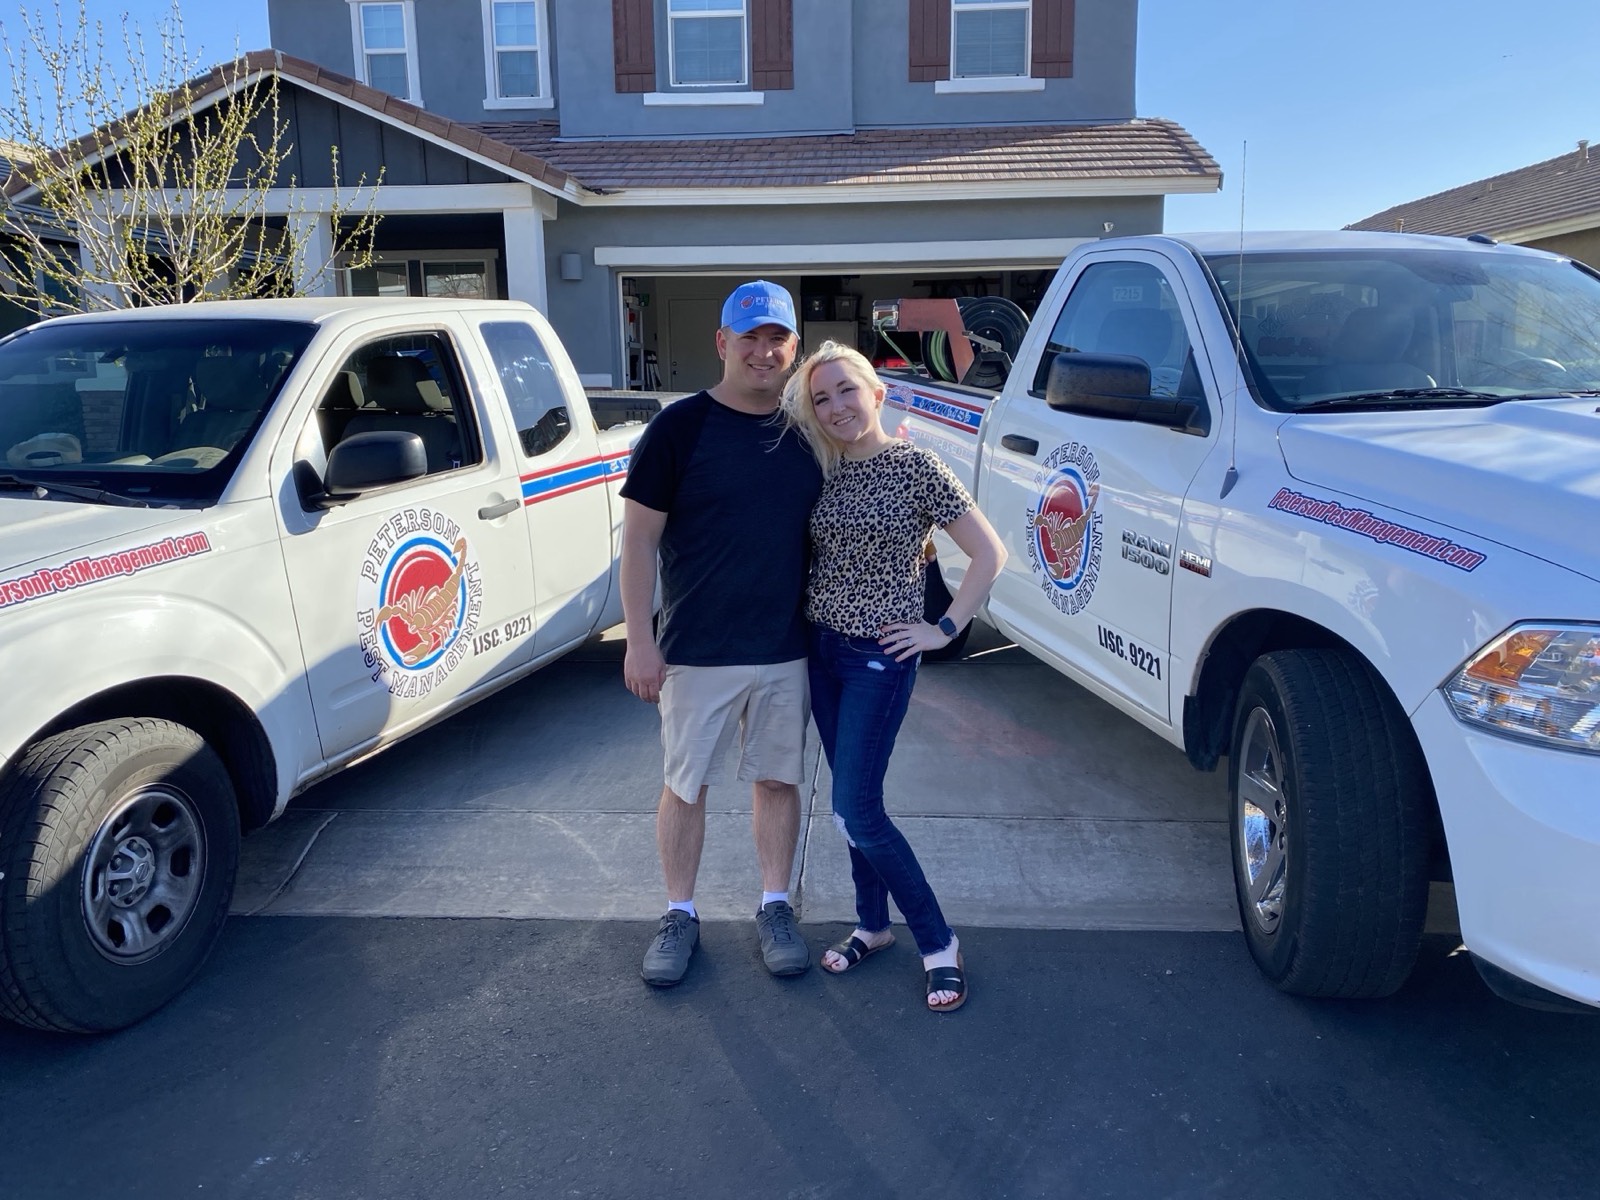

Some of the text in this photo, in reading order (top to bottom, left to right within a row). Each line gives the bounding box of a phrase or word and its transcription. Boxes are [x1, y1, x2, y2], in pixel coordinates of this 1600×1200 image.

[1034, 442, 1100, 490] PETERSON
[361, 508, 460, 583] PETERSON
[1122, 529, 1172, 558] RAM
[1270, 488, 1485, 571] PetersonPestManagement.com
[1026, 508, 1103, 615] PEST MANAGEMENT
[1121, 545, 1170, 575] 1500
[1180, 550, 1211, 568] HEMI
[357, 562, 483, 698] PEST MANAGEMENT
[472, 614, 532, 657] LISC. 9221
[1098, 624, 1162, 681] LISC. 9221
